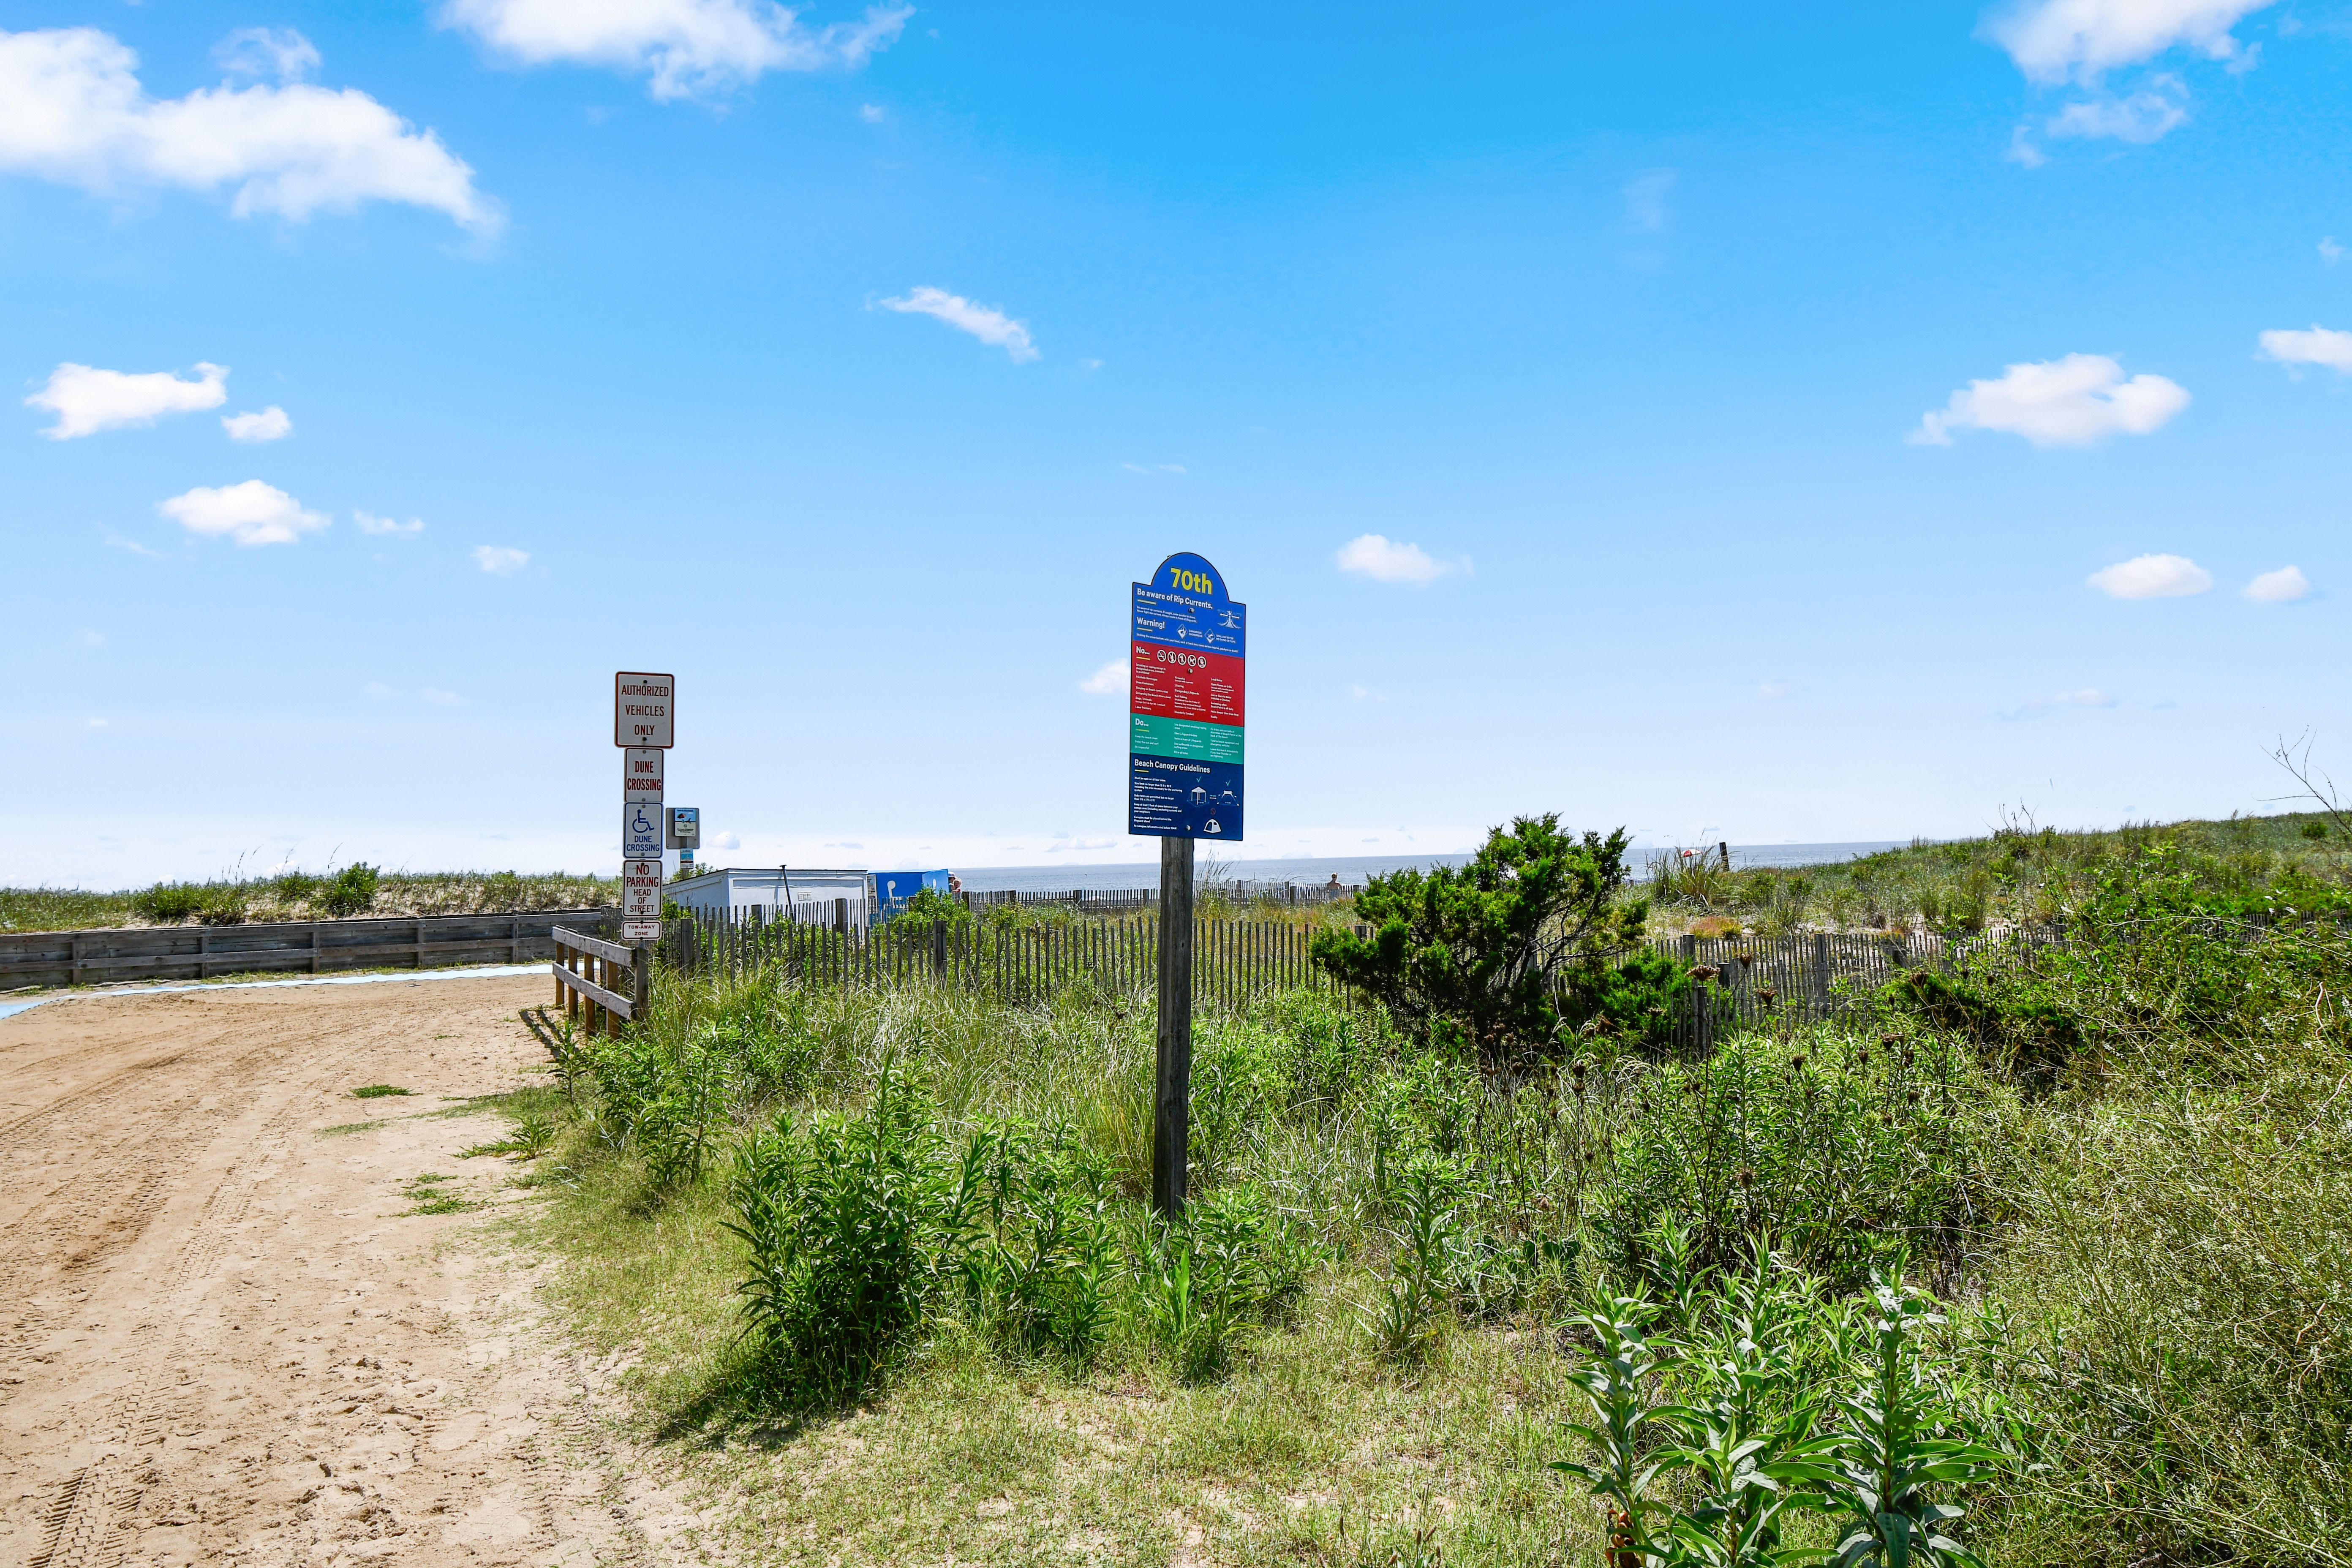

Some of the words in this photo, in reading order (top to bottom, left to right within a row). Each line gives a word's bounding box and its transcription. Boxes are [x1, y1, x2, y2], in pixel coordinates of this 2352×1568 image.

[1171, 567, 1212, 594] 70th
[1137, 588, 1145, 596] Be
[1146, 591, 1165, 600] aware
[1167, 593, 1173, 602] of
[1174, 595, 1184, 604] Rip
[1185, 597, 1213, 609] Currents.
[1137, 617, 1165, 629] Warning!
[1136, 646, 1150, 655] No...
[621, 685, 669, 697] AUTHORIZED
[626, 705, 664, 716] VEHICLES
[1135, 718, 1149, 726] Do...
[634, 725, 655, 735] ONLY
[635, 761, 653, 773] DUNE
[1135, 759, 1154, 767] Beach
[1155, 761, 1177, 771] Canopy
[1179, 763, 1210, 773] Guidelines
[627, 778, 661, 790] CROSSING
[636, 865, 649, 875] NO
[626, 877, 659, 887] PARKING
